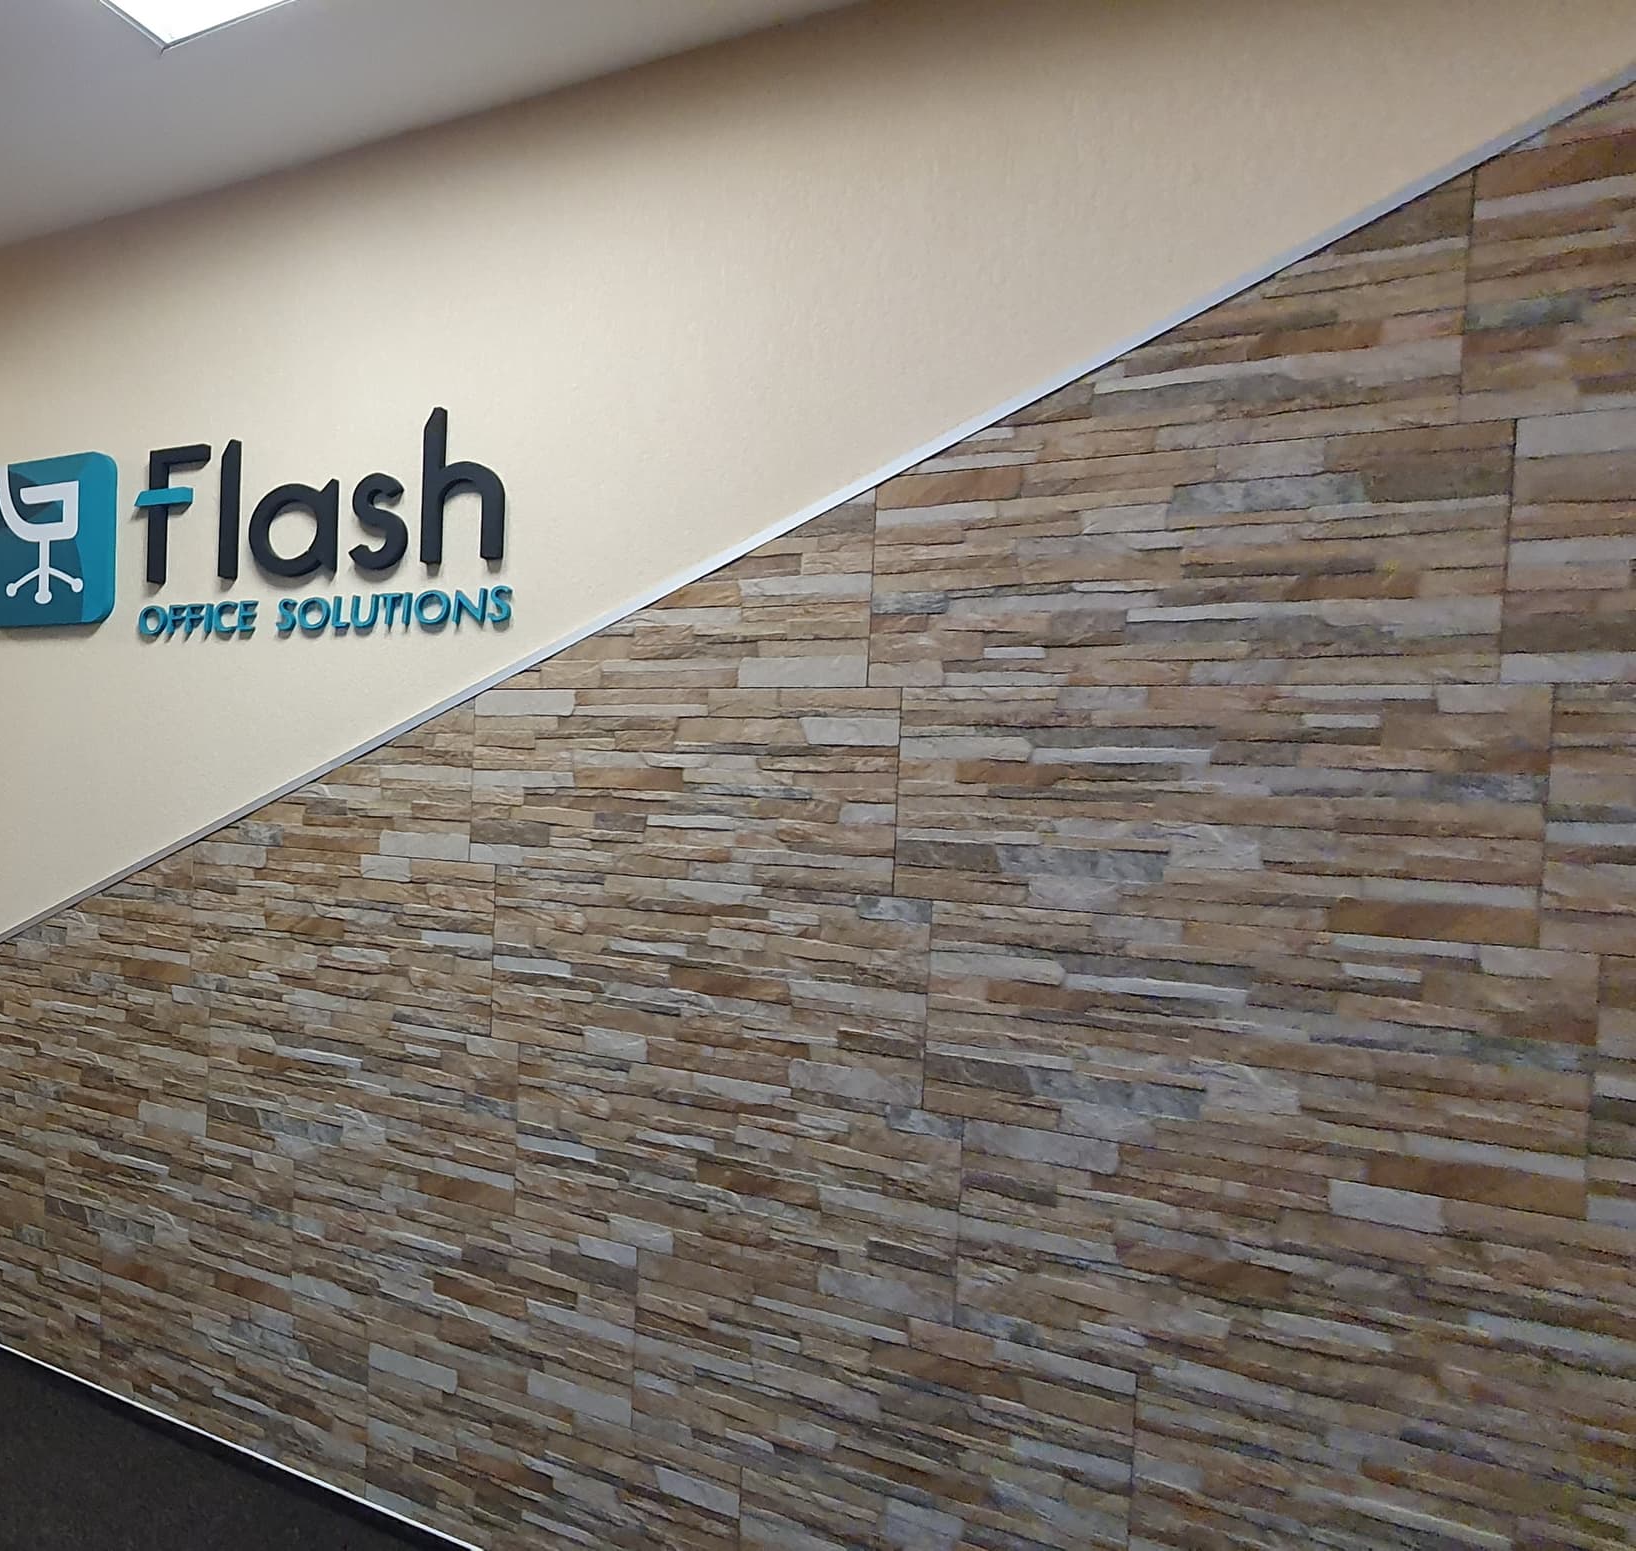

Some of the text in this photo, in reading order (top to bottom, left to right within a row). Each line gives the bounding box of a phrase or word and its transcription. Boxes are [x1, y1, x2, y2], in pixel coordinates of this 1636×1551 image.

[132, 406, 505, 586] Flash
[137, 583, 514, 637] OFFICE SOLUTIONS
